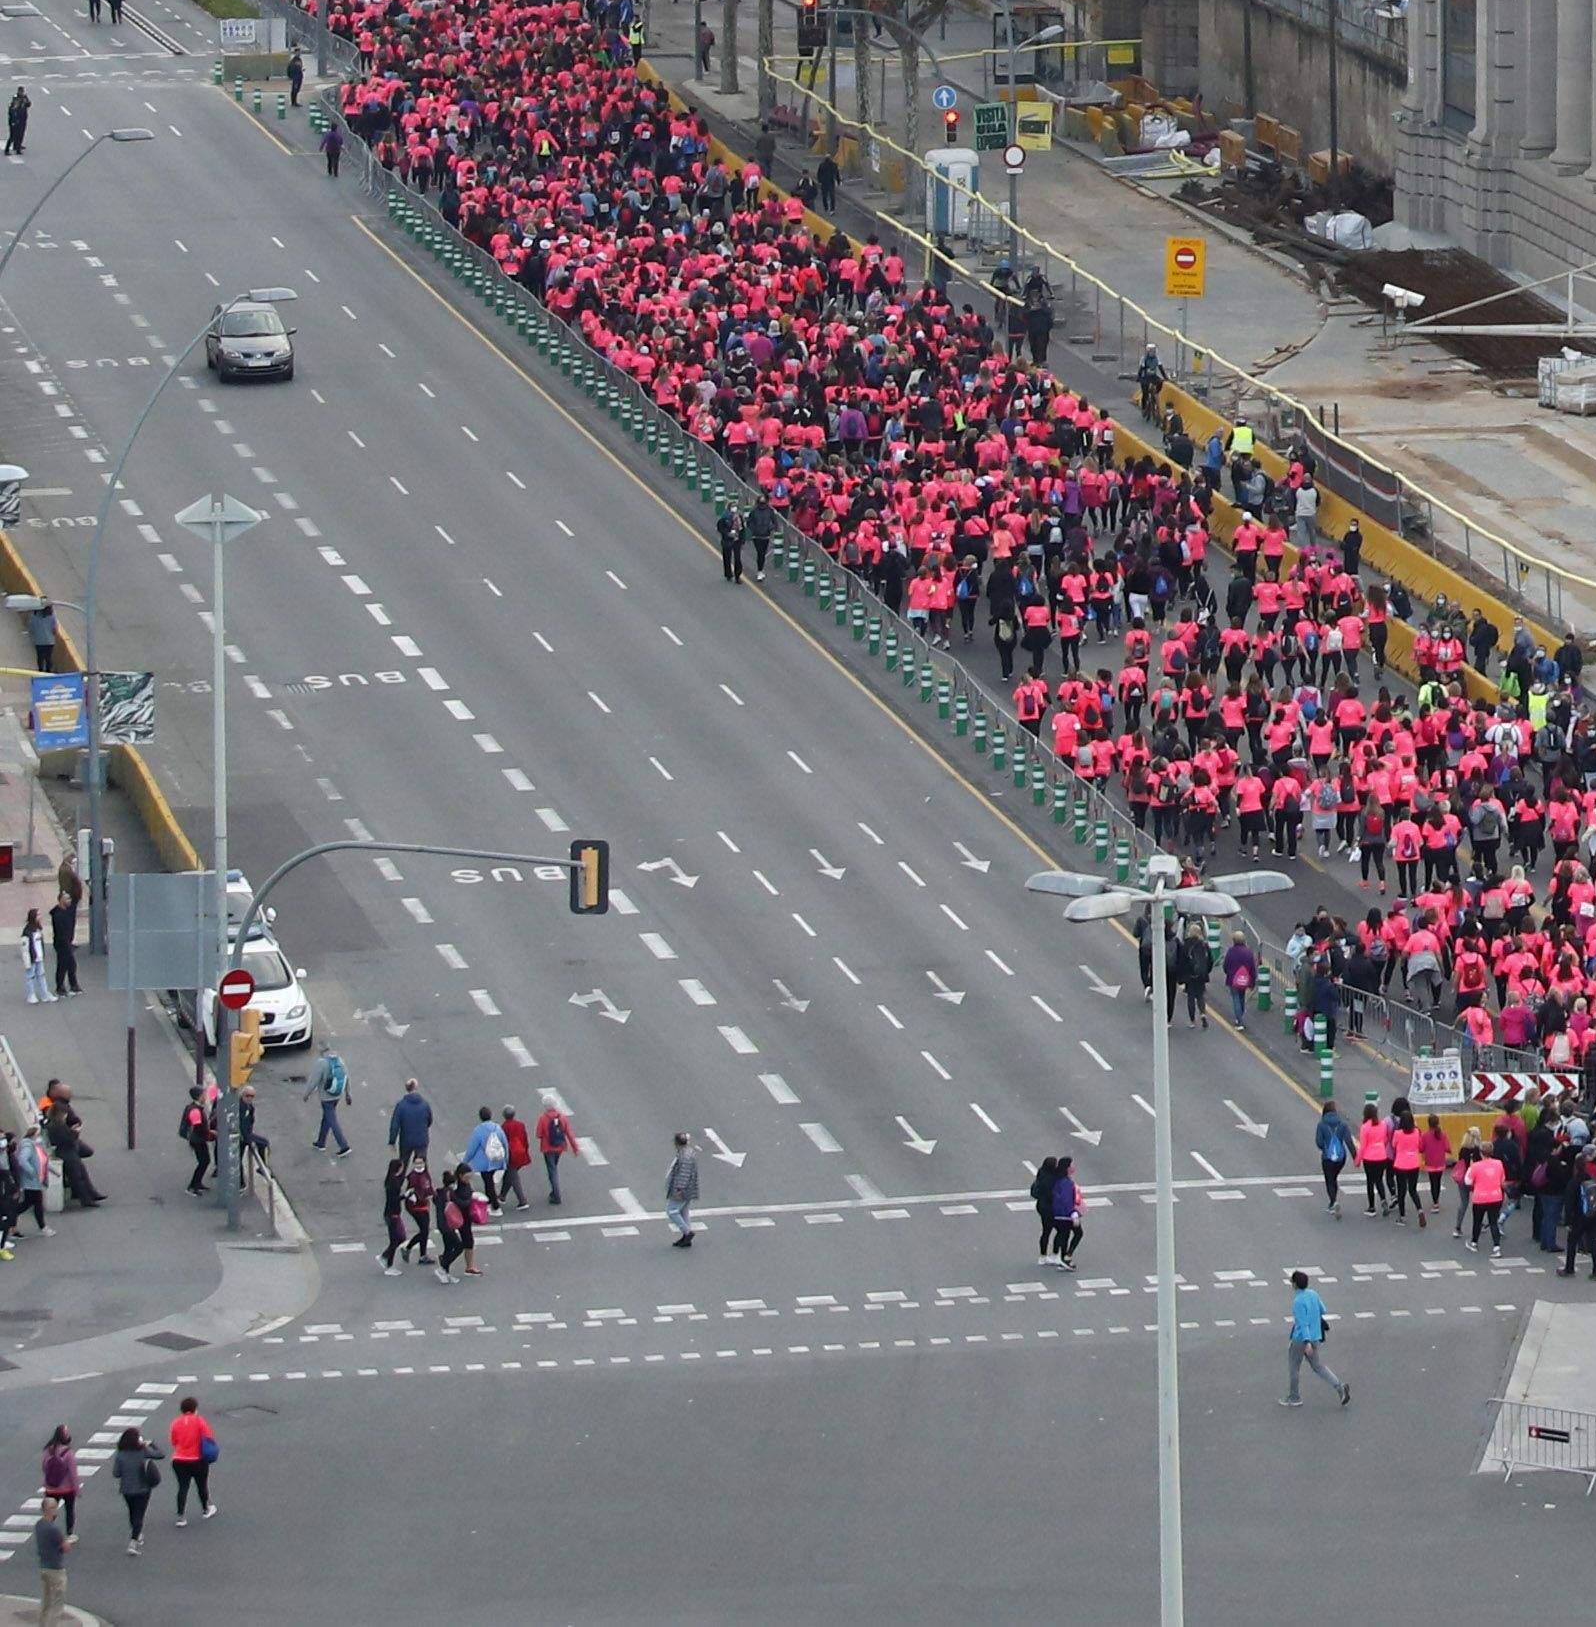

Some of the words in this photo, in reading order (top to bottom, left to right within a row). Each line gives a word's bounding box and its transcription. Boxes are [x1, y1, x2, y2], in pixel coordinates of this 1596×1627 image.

[65, 357, 150, 369] BUS
[303, 670, 407, 690] BUS
[450, 865, 568, 885] BUS
